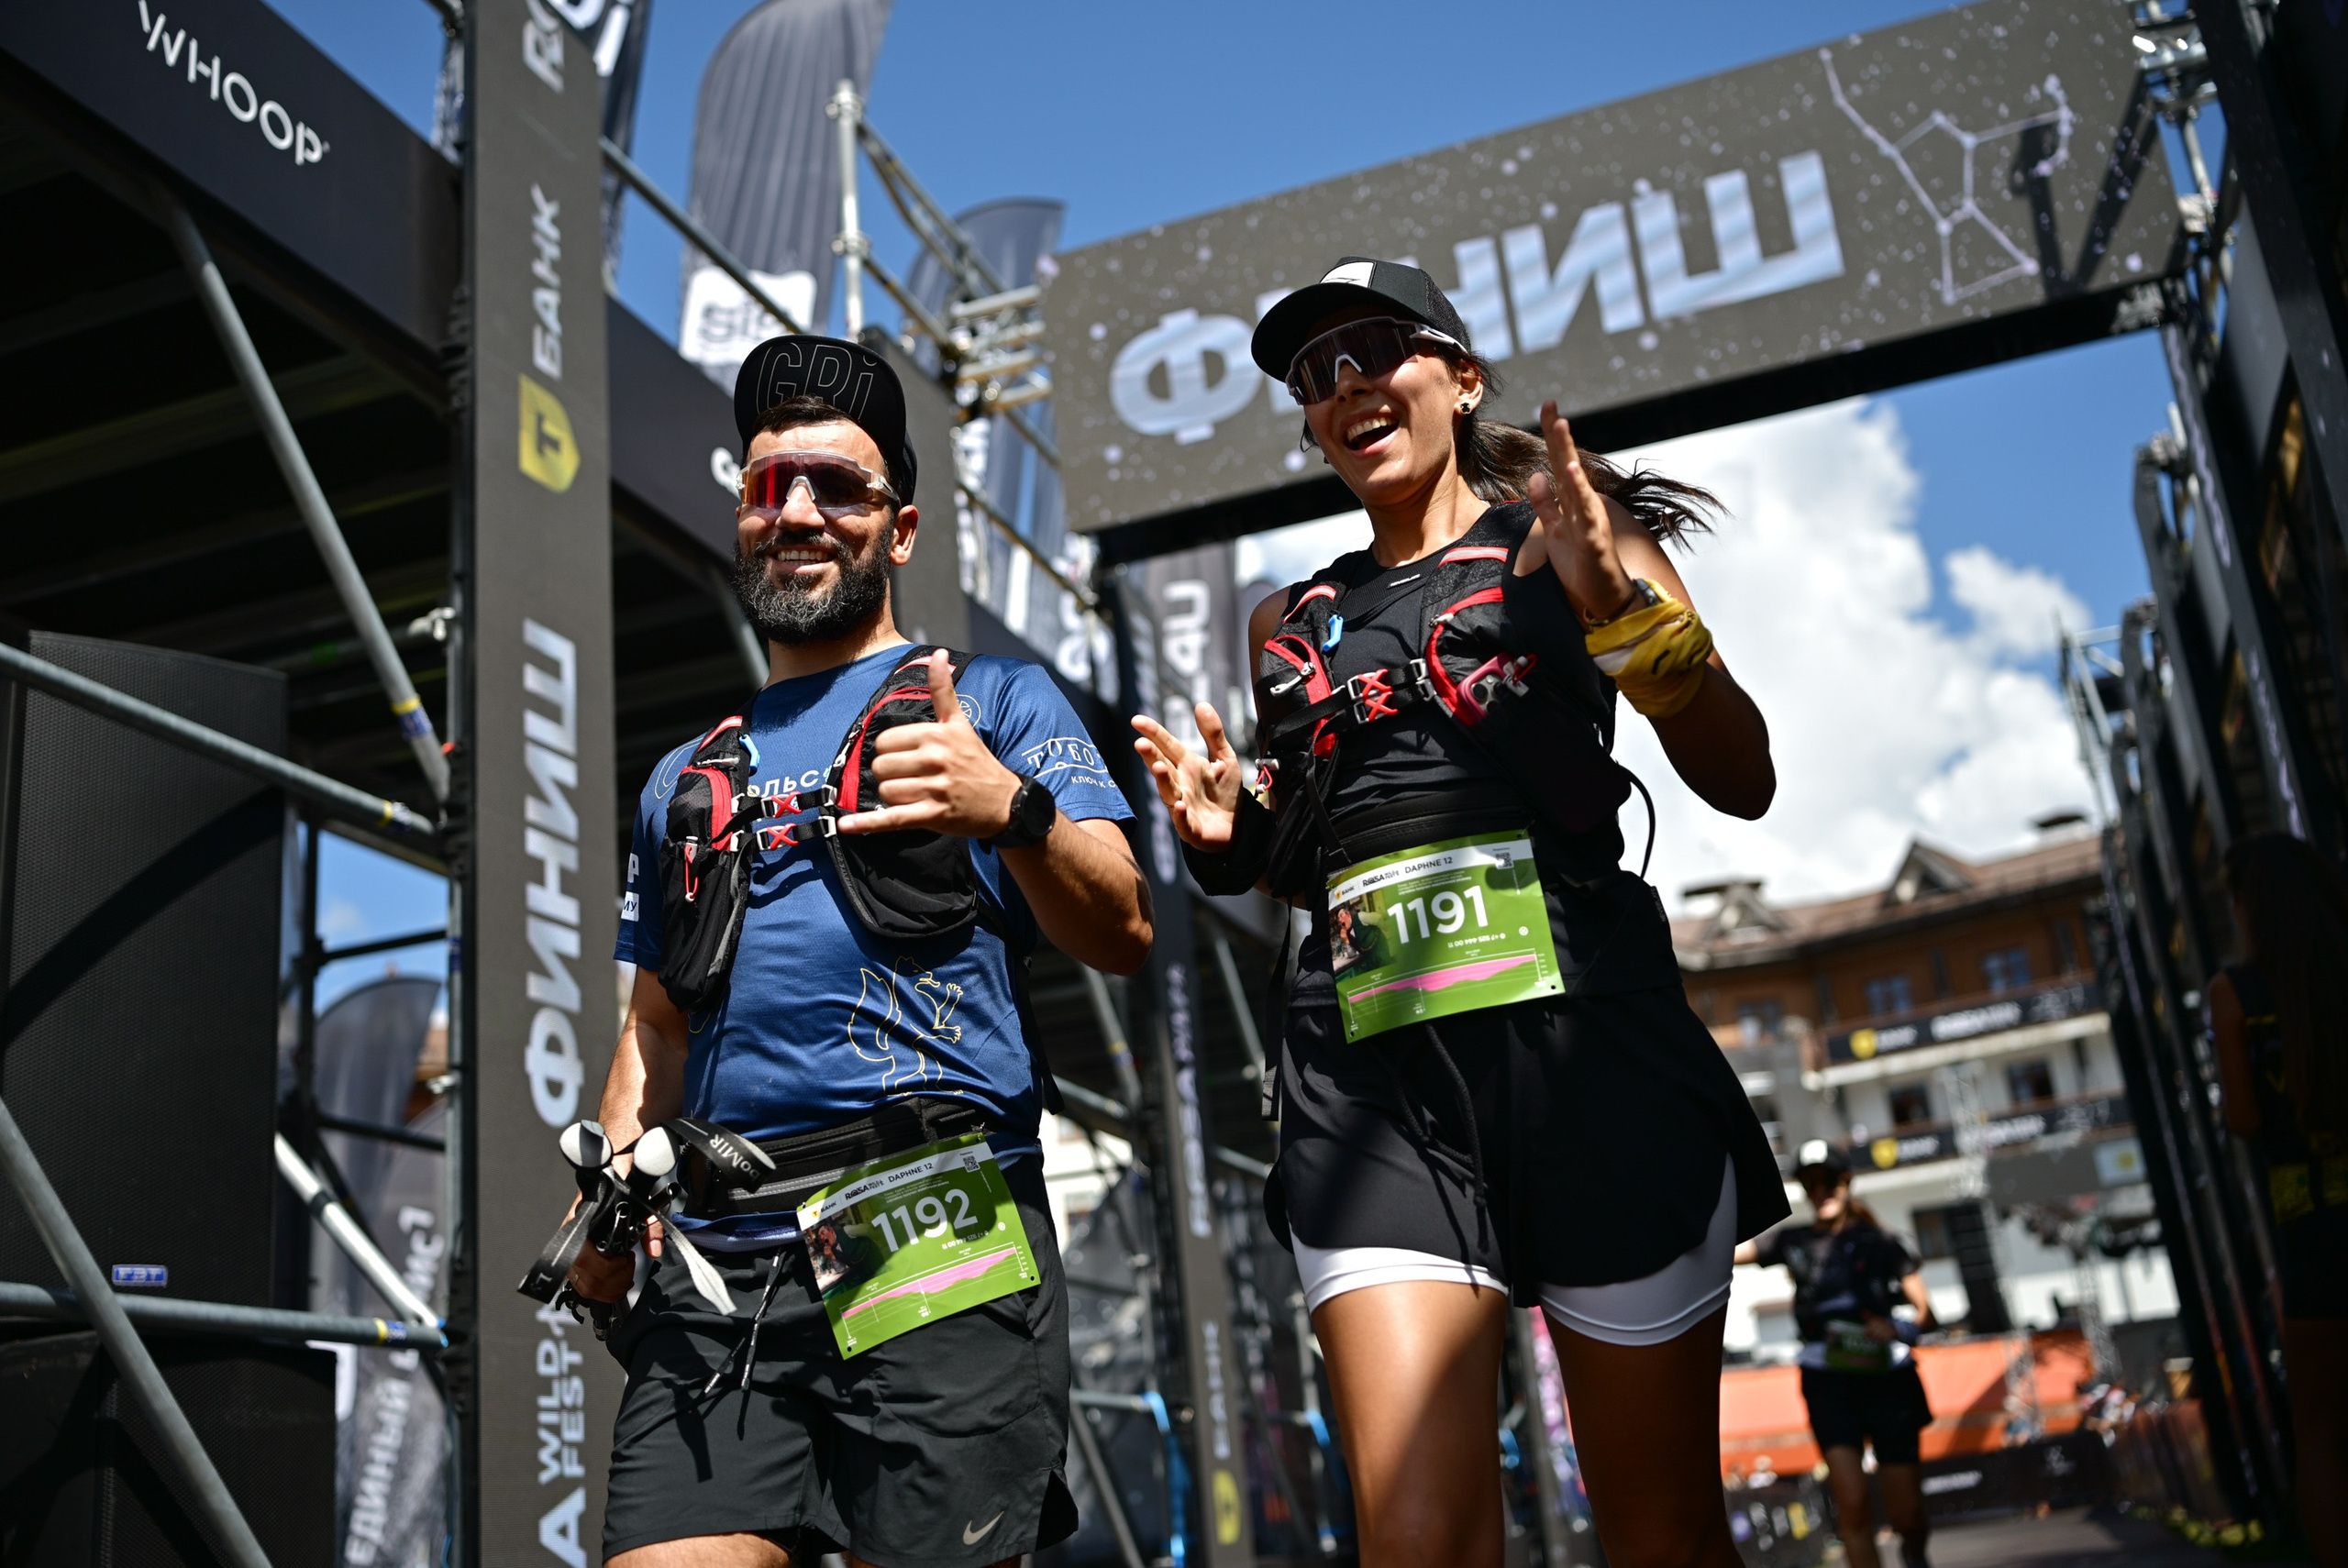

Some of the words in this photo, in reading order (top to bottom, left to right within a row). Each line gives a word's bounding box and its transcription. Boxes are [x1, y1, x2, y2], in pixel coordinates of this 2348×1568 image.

[138, 0, 324, 165] WHOOP
[531, 183, 561, 379] БАНК
[1109, 149, 1845, 446] ФНИШ
[1027, 739, 1107, 773] ТОБО
[1071, 775, 1098, 787] КЛЮЧ
[522, 617, 585, 1128] ФИНИШ
[1387, 885, 1488, 944] 1191
[1404, 858, 1442, 874] DAPHNE
[1444, 856, 1453, 865] 12
[871, 1188, 979, 1253] 1192
[888, 1165, 924, 1183] DAPHNE
[536, 1339, 561, 1485] WILD
[559, 1339, 586, 1479] FEST
